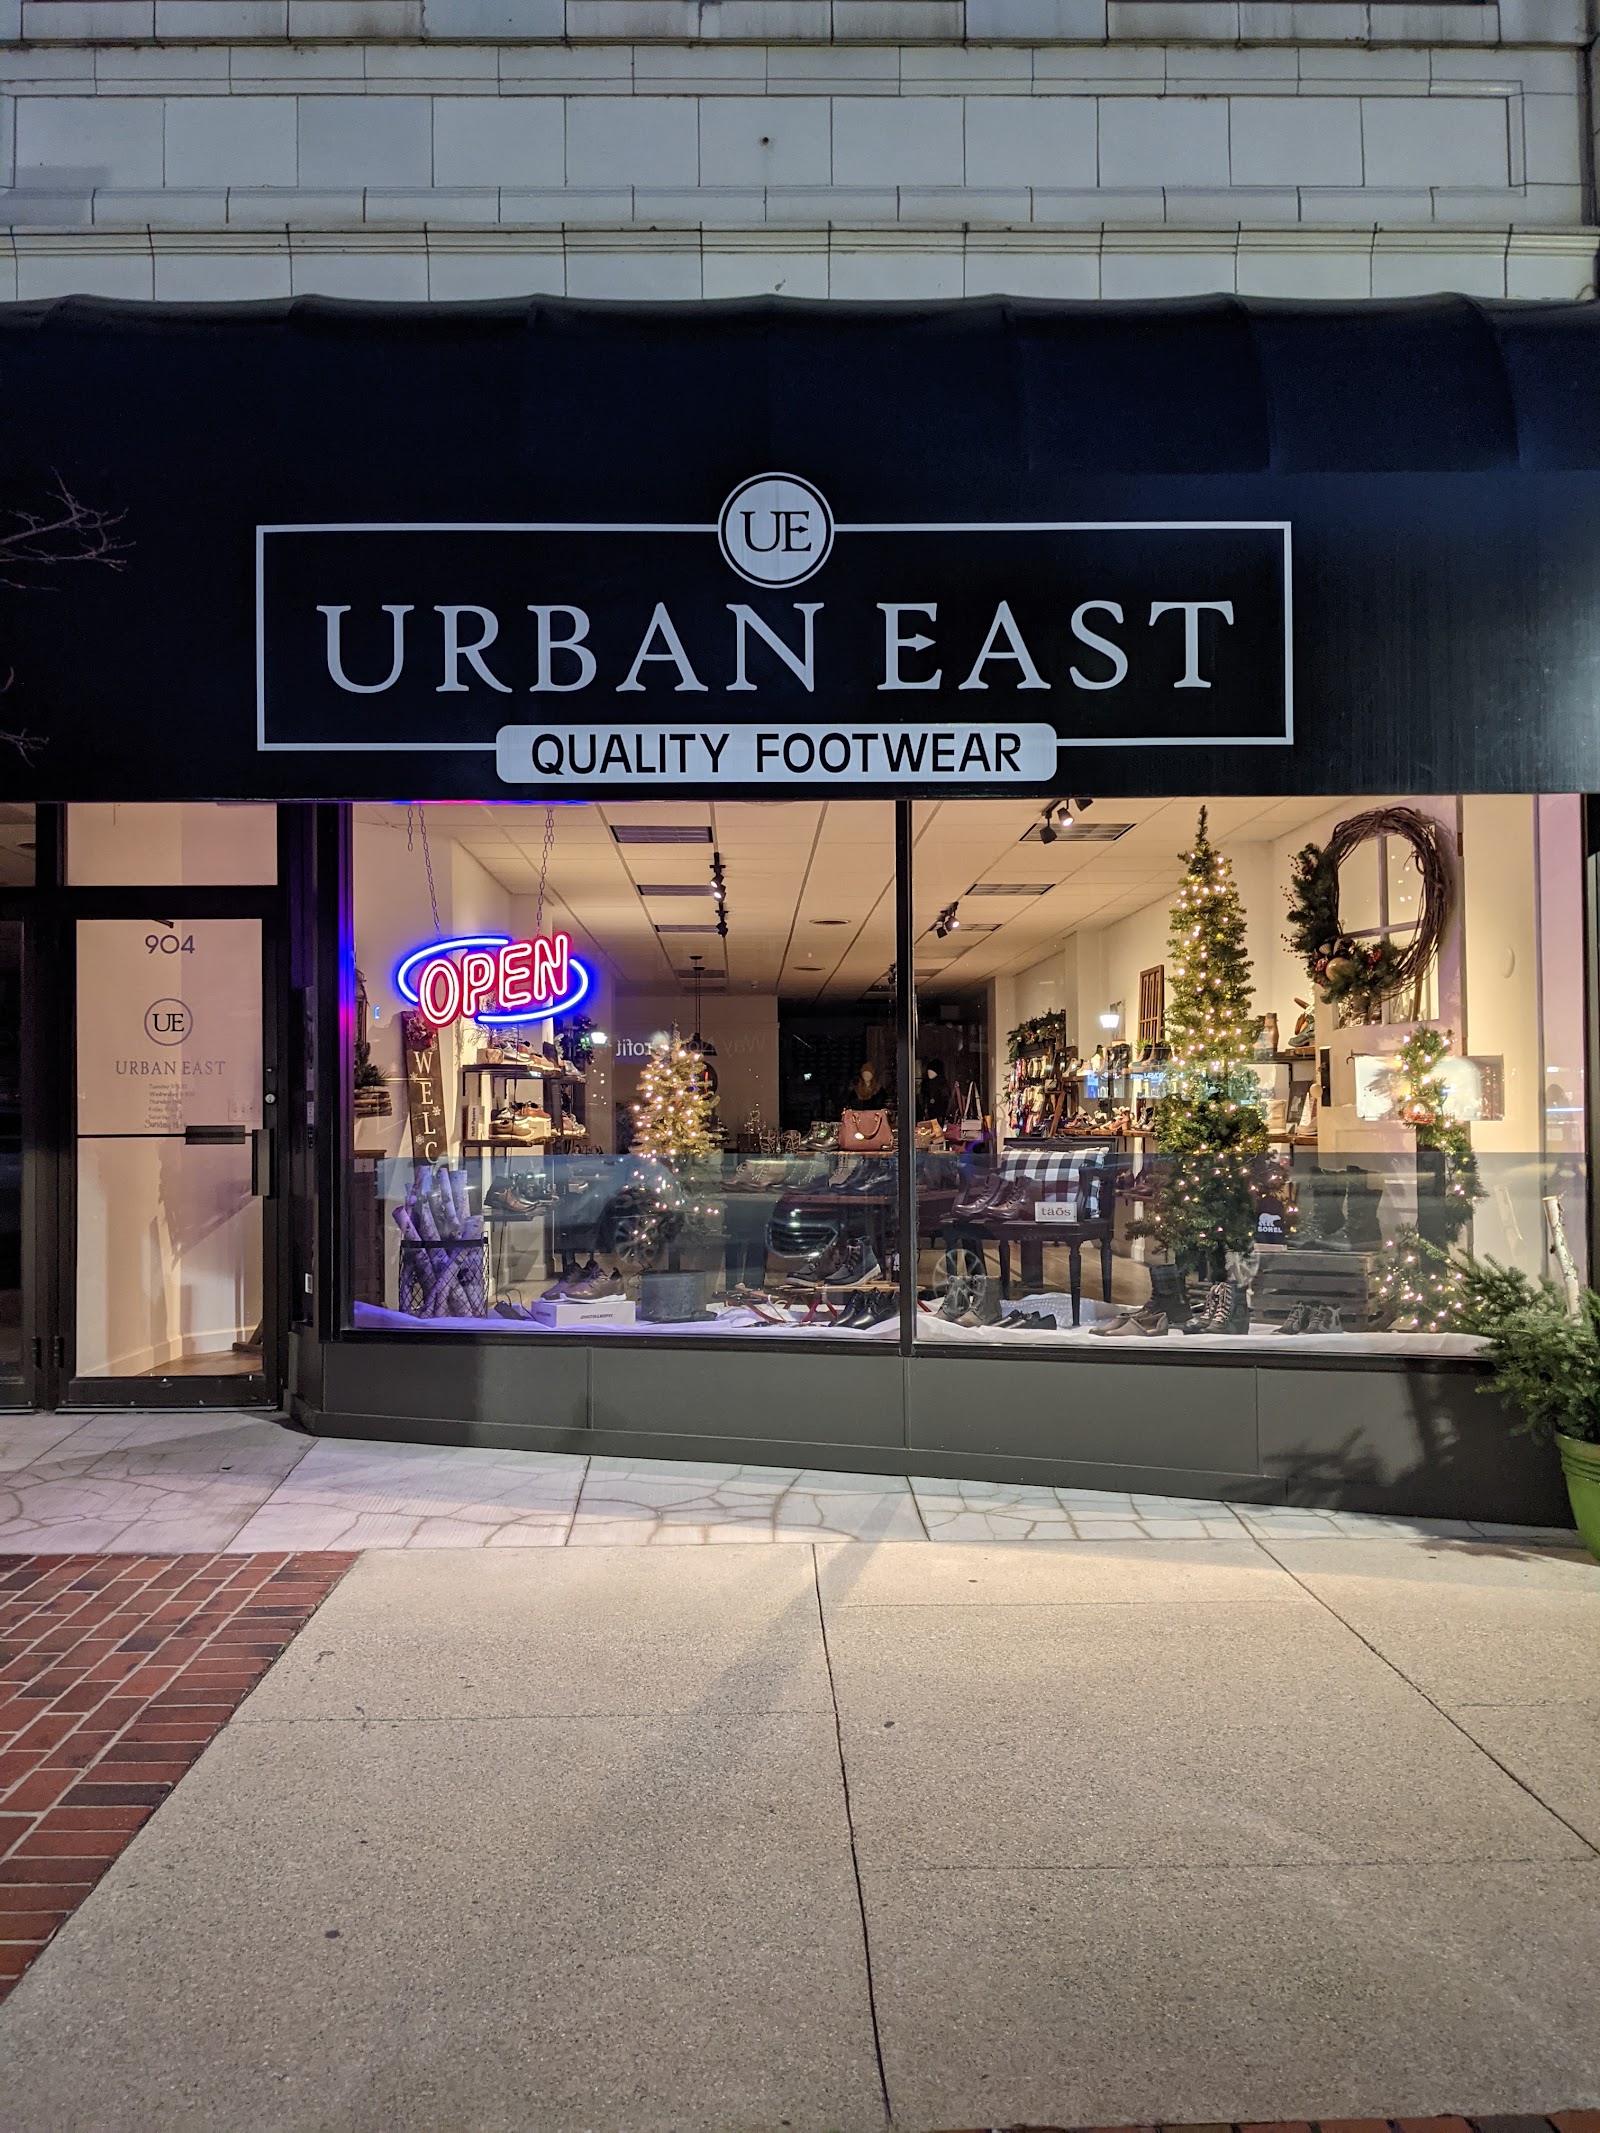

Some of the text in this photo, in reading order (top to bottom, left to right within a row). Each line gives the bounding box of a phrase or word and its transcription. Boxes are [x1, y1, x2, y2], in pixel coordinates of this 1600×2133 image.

[740, 510, 813, 553] UE
[316, 600, 1234, 694] URBAN EAST
[531, 732, 1021, 776] QUALITY FOOTWEAR
[145, 934, 196, 954] 904
[418, 933, 570, 1027] OPEN
[152, 1013, 185, 1032] UE
[115, 1060, 226, 1075] URBAN EAST
